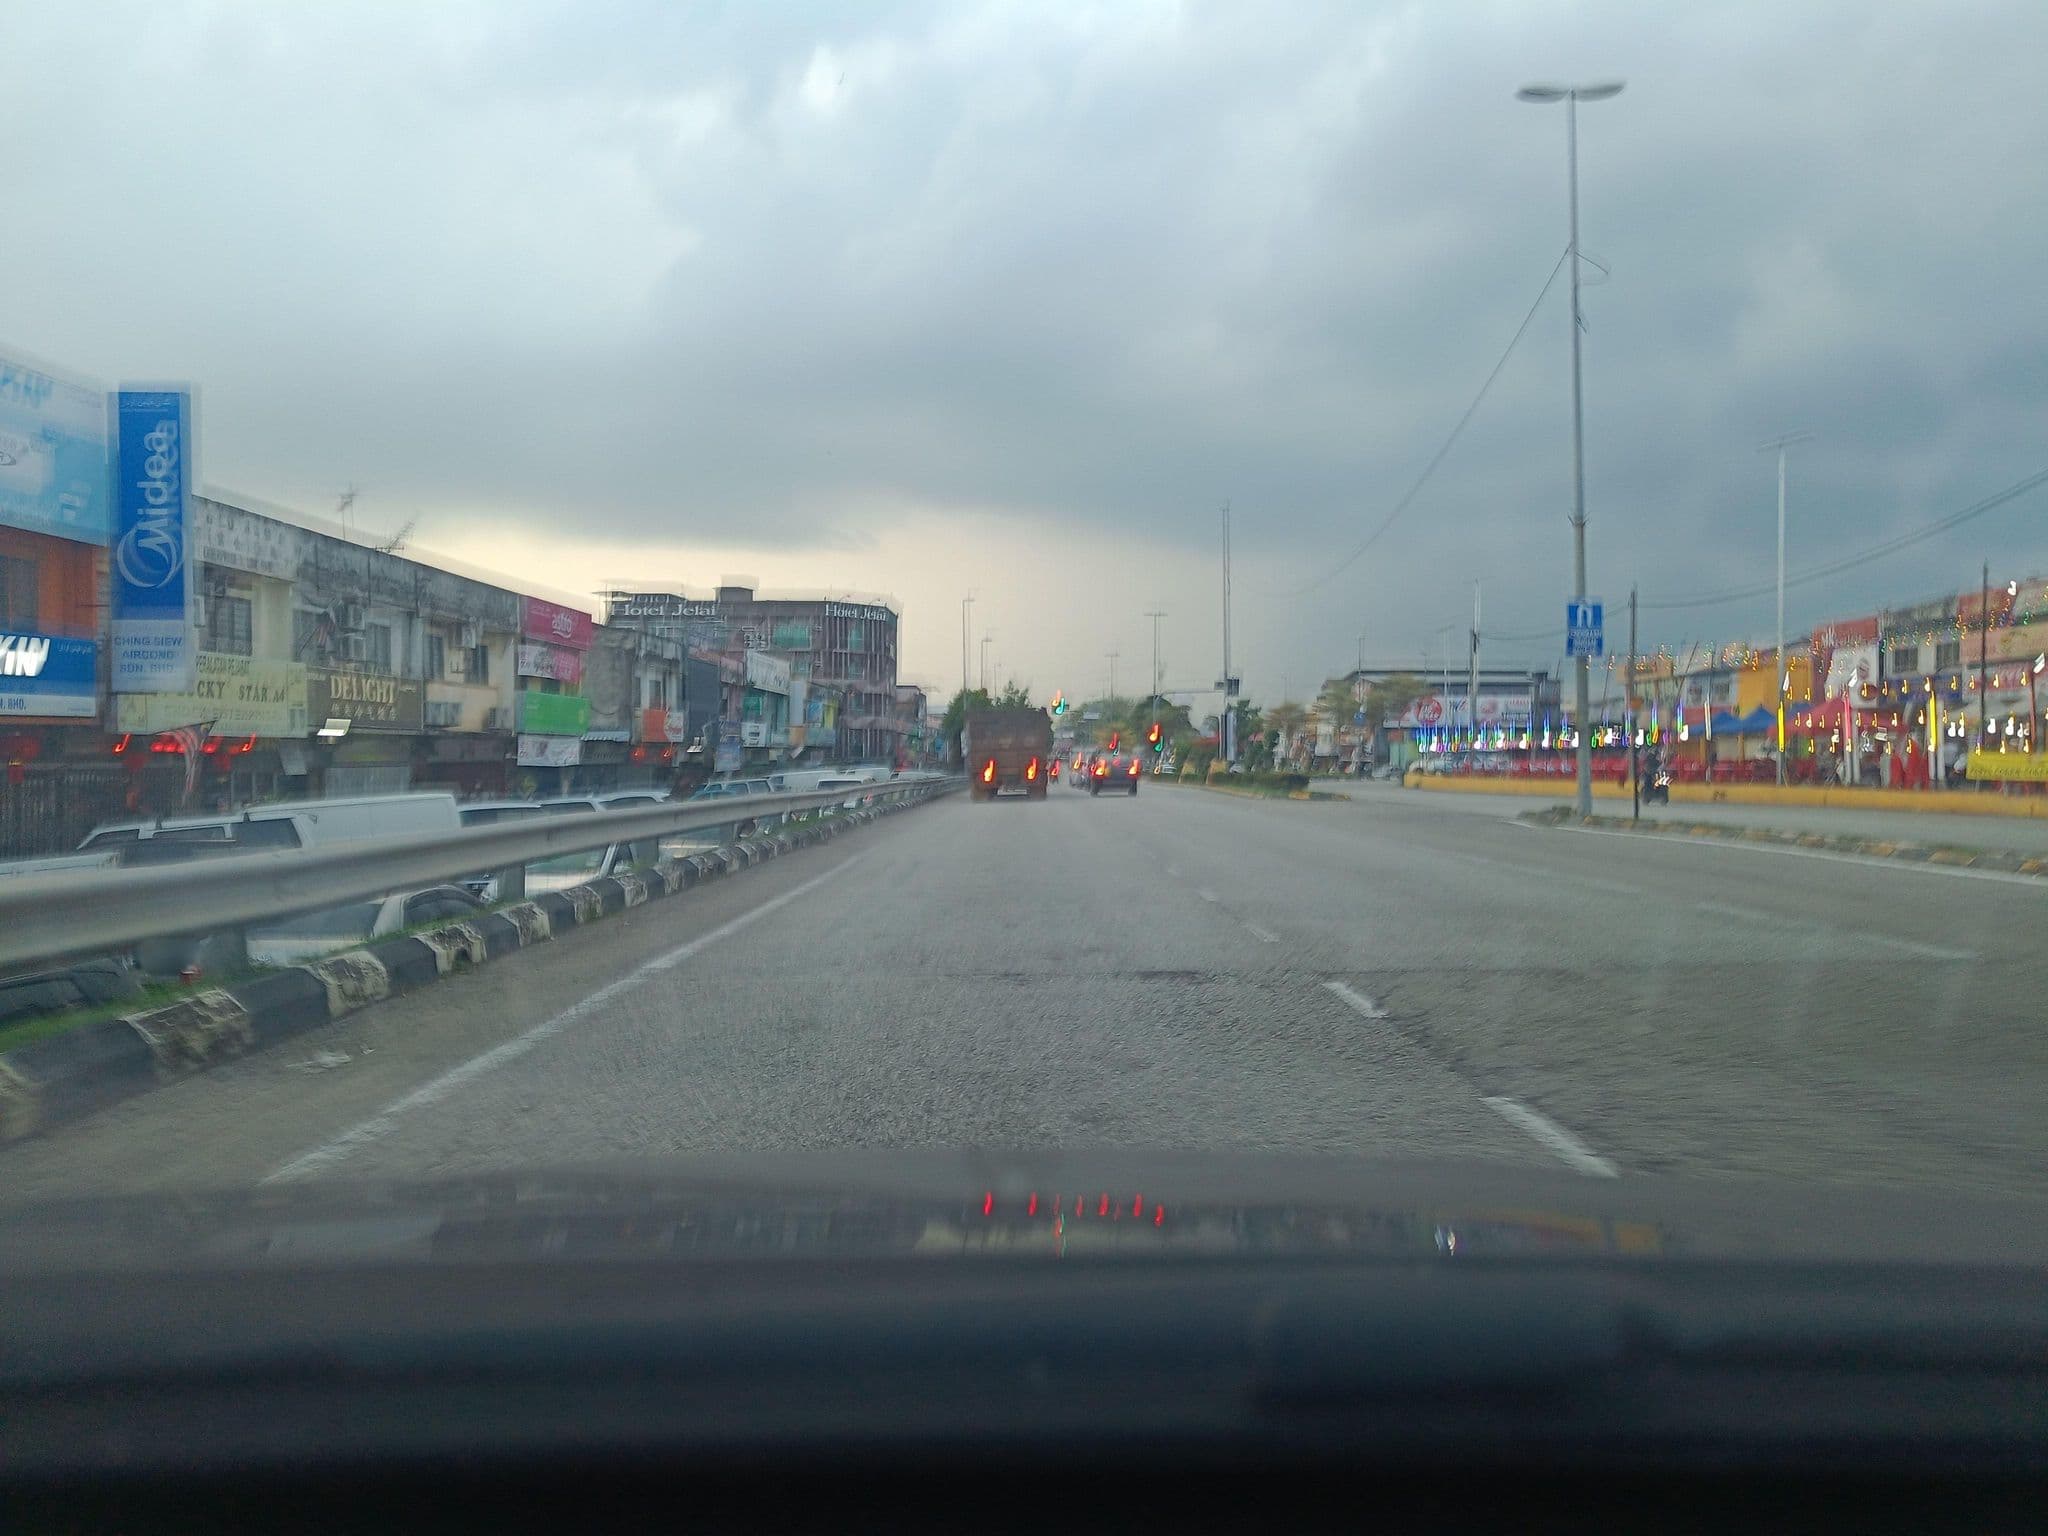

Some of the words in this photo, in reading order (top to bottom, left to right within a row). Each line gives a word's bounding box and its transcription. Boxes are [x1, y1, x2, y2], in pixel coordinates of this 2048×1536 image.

[137, 421, 176, 565] Midea
[611, 604, 665, 616] Hotel
[671, 604, 716, 616] Jelai
[825, 604, 858, 619] Hotel
[860, 608, 887, 621] Jelai
[238, 684, 269, 703] STAR
[330, 675, 396, 704] DELIGHT
